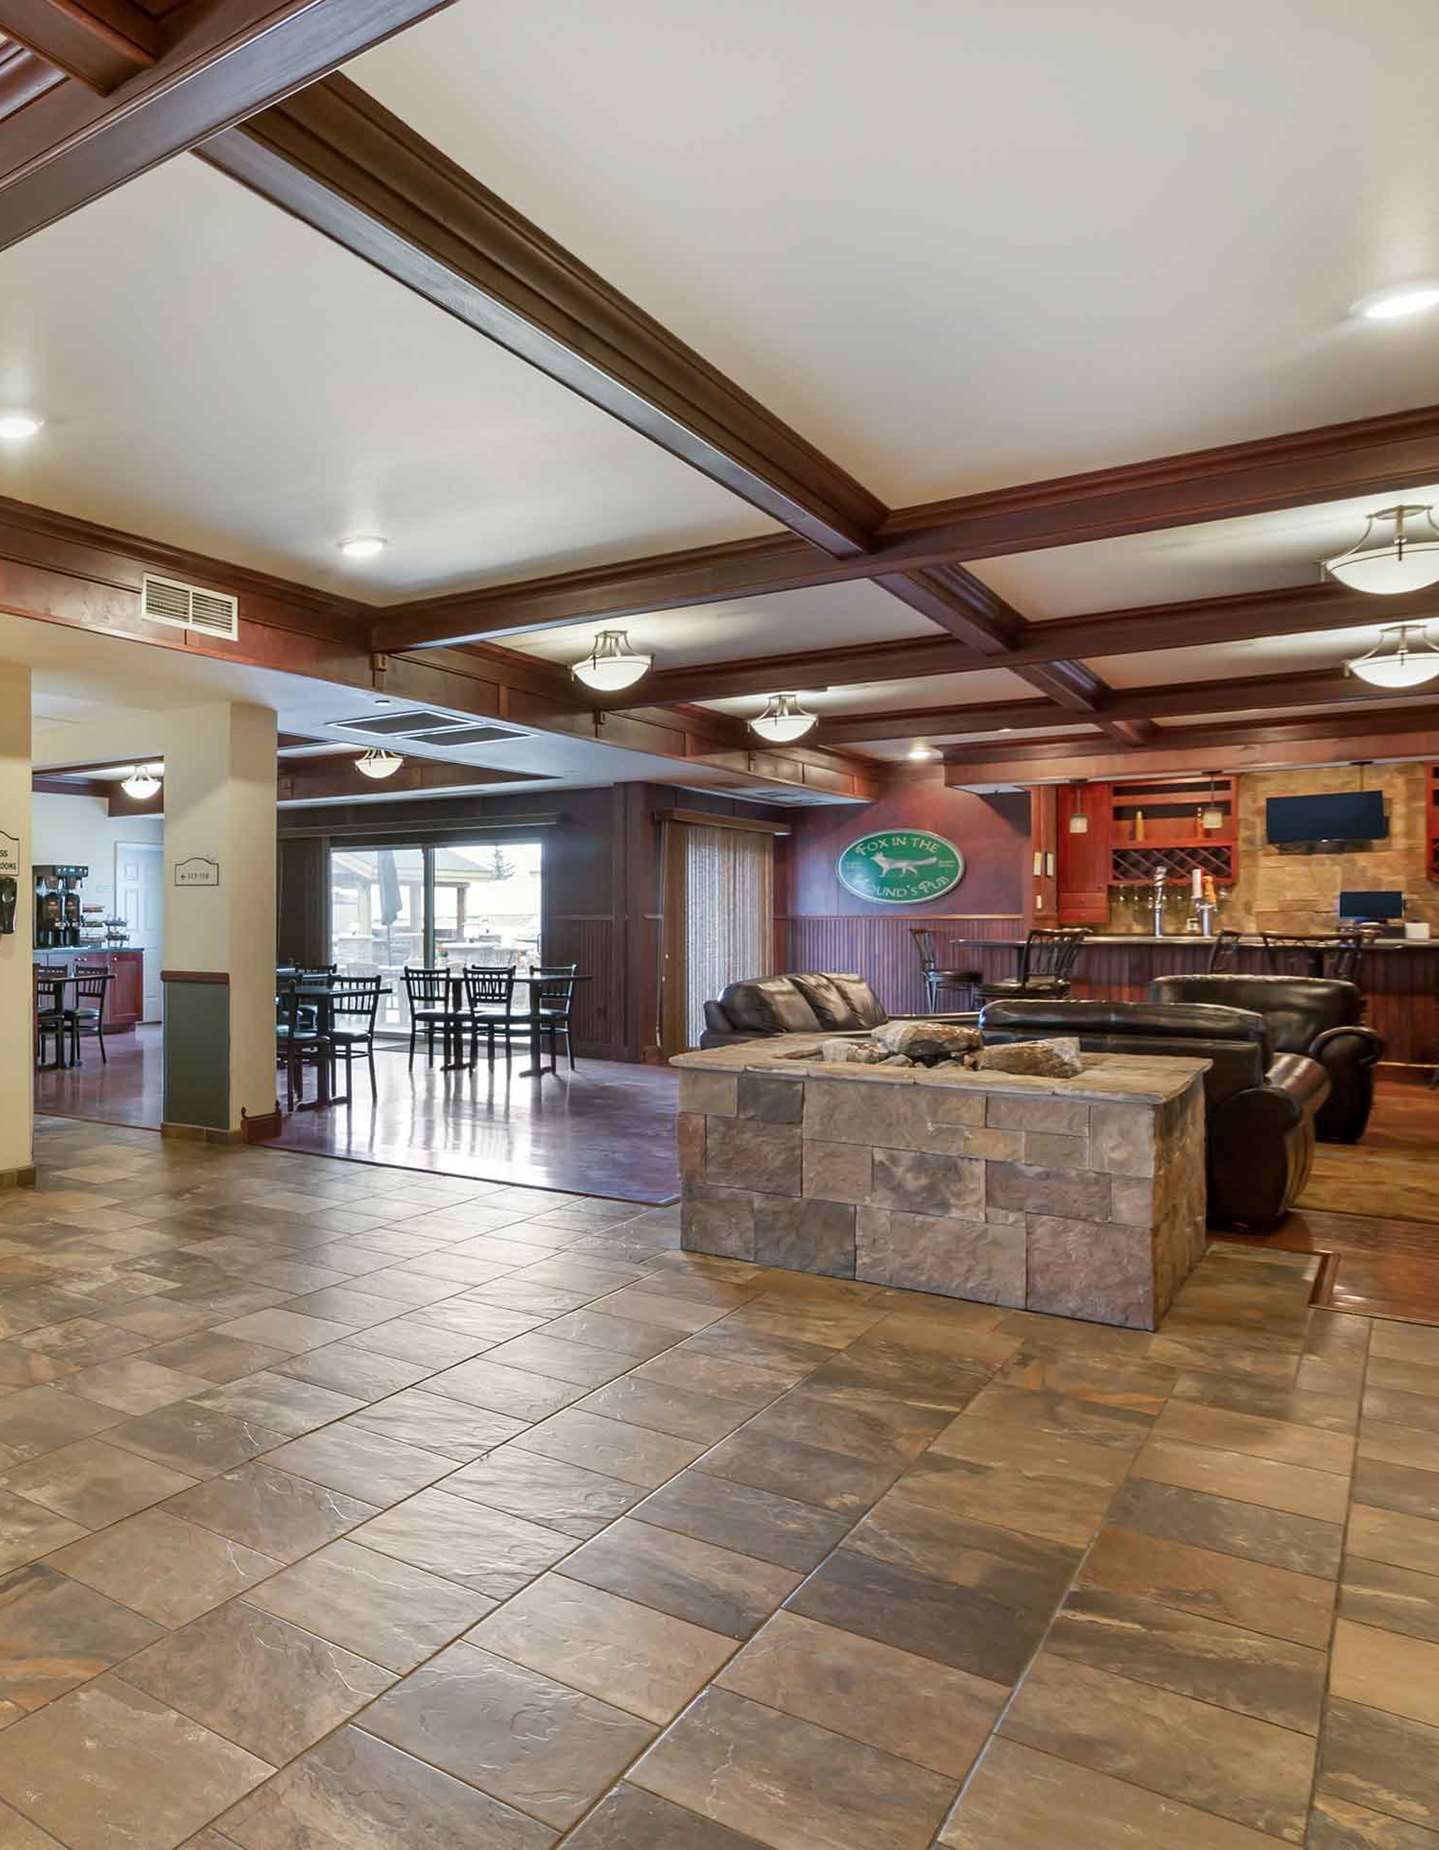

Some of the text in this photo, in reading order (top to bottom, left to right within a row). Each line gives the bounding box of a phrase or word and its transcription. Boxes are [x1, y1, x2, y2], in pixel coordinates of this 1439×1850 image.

[854, 836, 941, 856] FOX IN THE
[853, 873, 918, 898] OUND'S
